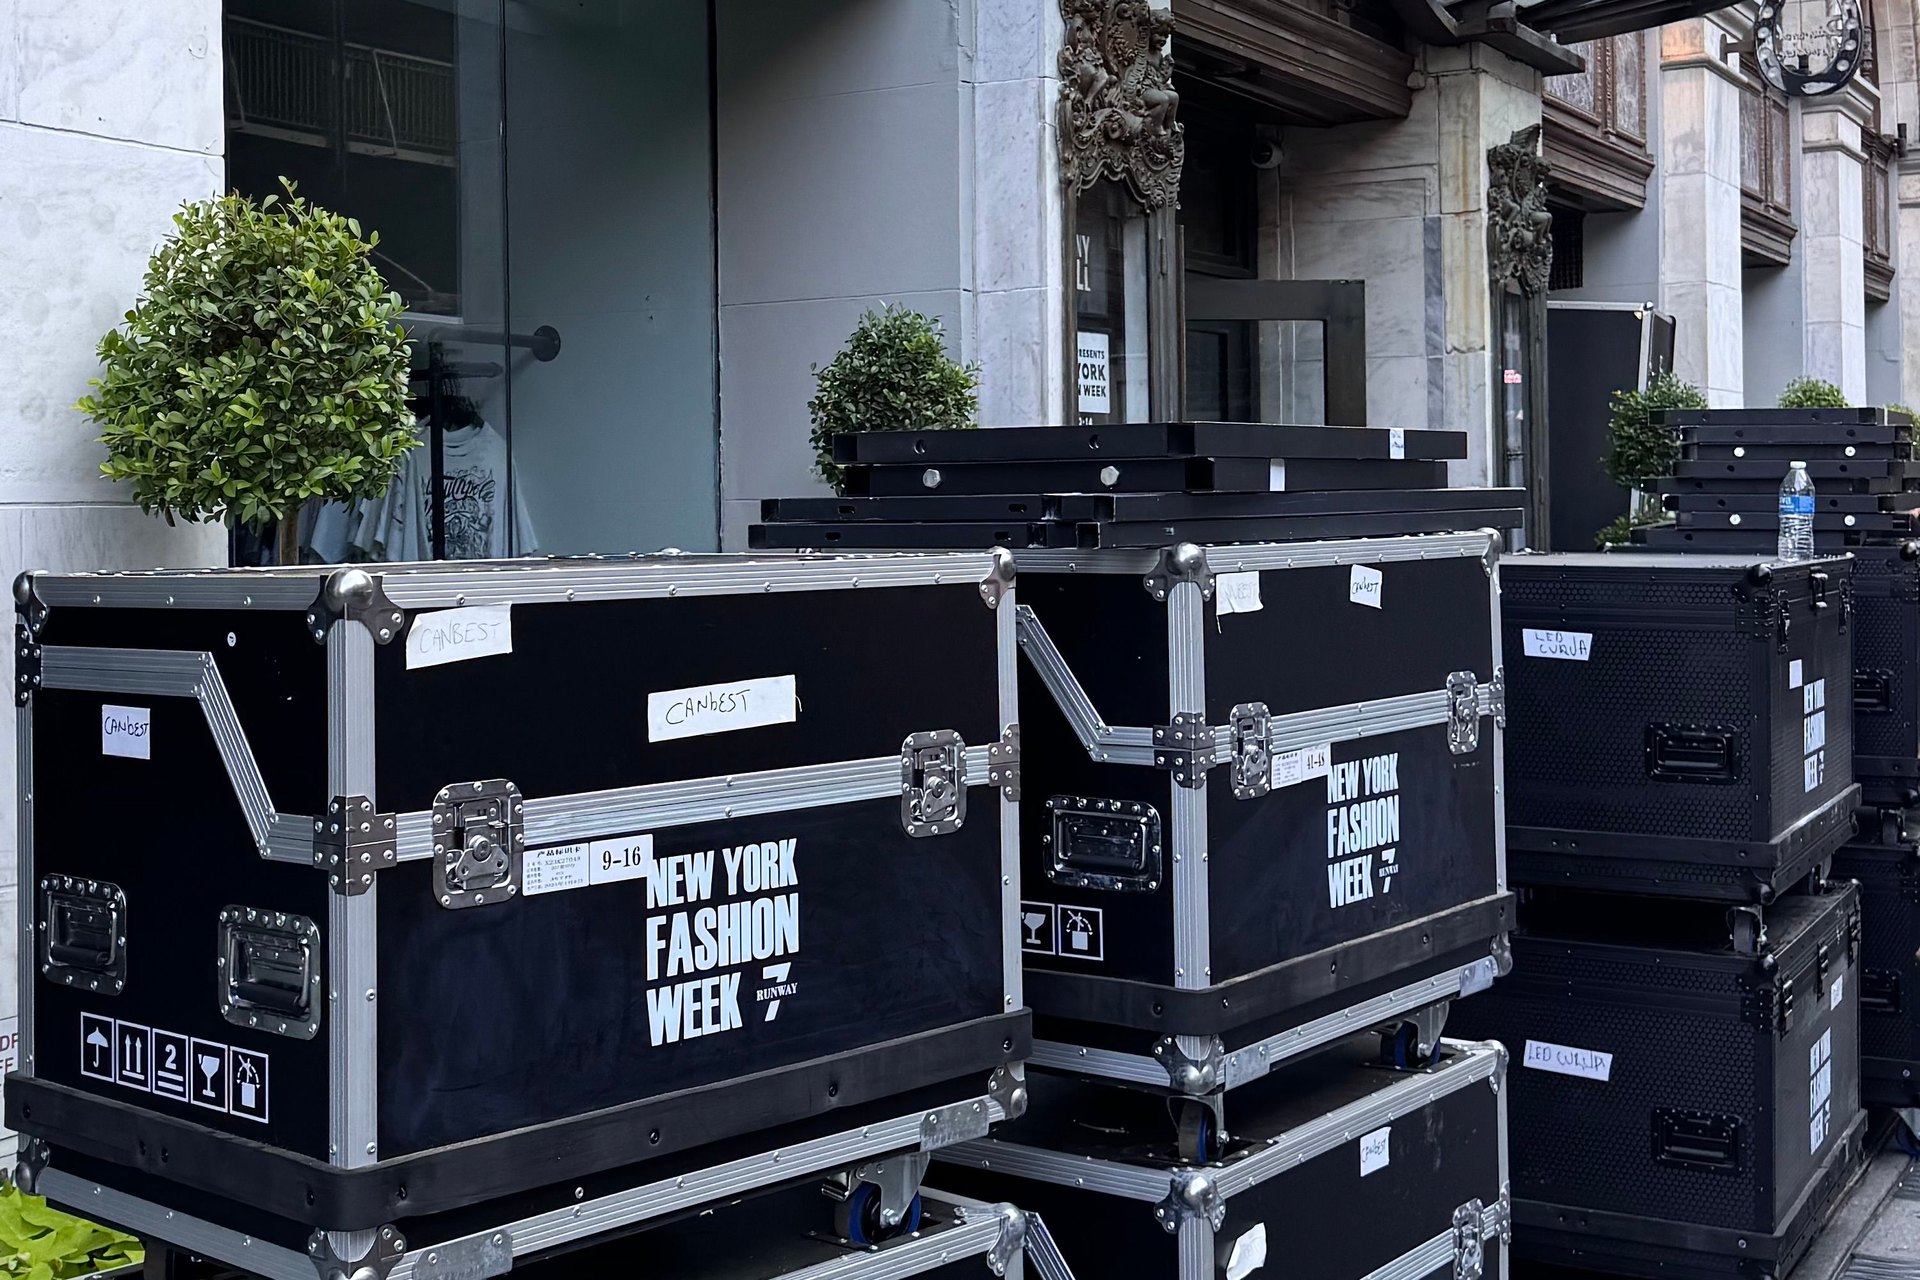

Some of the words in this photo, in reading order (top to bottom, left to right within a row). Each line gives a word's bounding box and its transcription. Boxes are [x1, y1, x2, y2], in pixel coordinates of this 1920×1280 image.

[1083, 385, 1107, 398] WEEK
[419, 619, 502, 654] CANBEST
[1327, 759, 1360, 804] NEW
[1362, 752, 1399, 796] YORK
[1327, 795, 1400, 859] FASHION
[602, 846, 641, 871] 9-16
[646, 850, 715, 909] NEW
[722, 838, 799, 896] YORK
[1327, 854, 1374, 909] WEEK
[646, 892, 799, 981] FASHION
[646, 971, 743, 1047] WEEK
[756, 982, 798, 1002] RUNWAY
